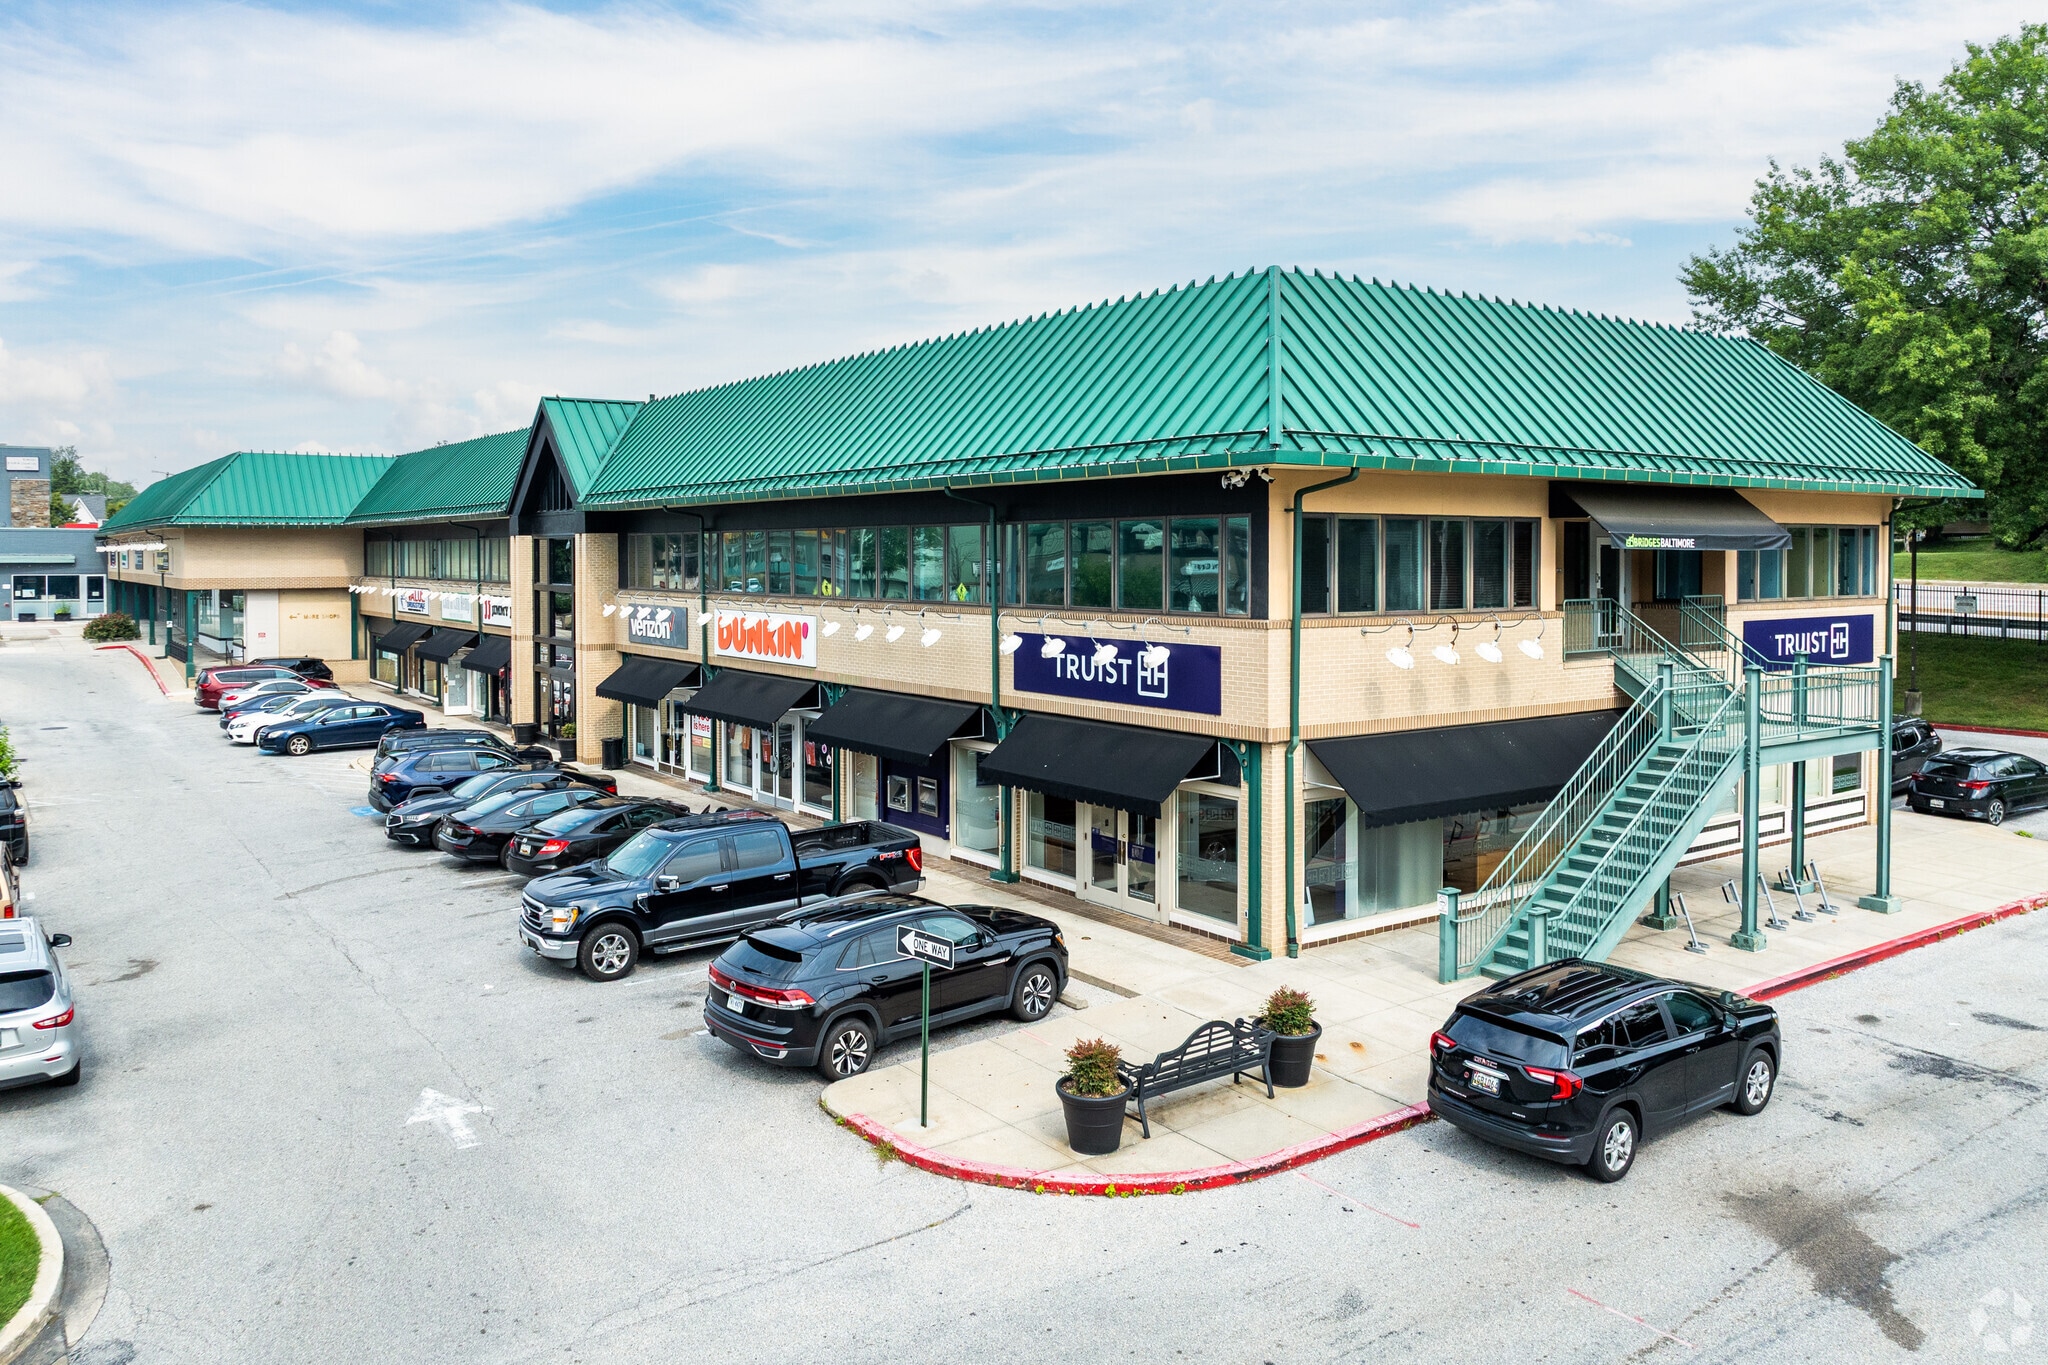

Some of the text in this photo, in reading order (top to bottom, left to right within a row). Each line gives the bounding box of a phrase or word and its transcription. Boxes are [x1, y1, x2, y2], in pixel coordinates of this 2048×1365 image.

[631, 615, 671, 639] verizon
[1774, 631, 1829, 657] TRUIST
[1056, 653, 1132, 685] TRUIST
[698, 720, 710, 733] here
[913, 938, 947, 958] ONE WAY
[1473, 1055, 1498, 1069] GMC
